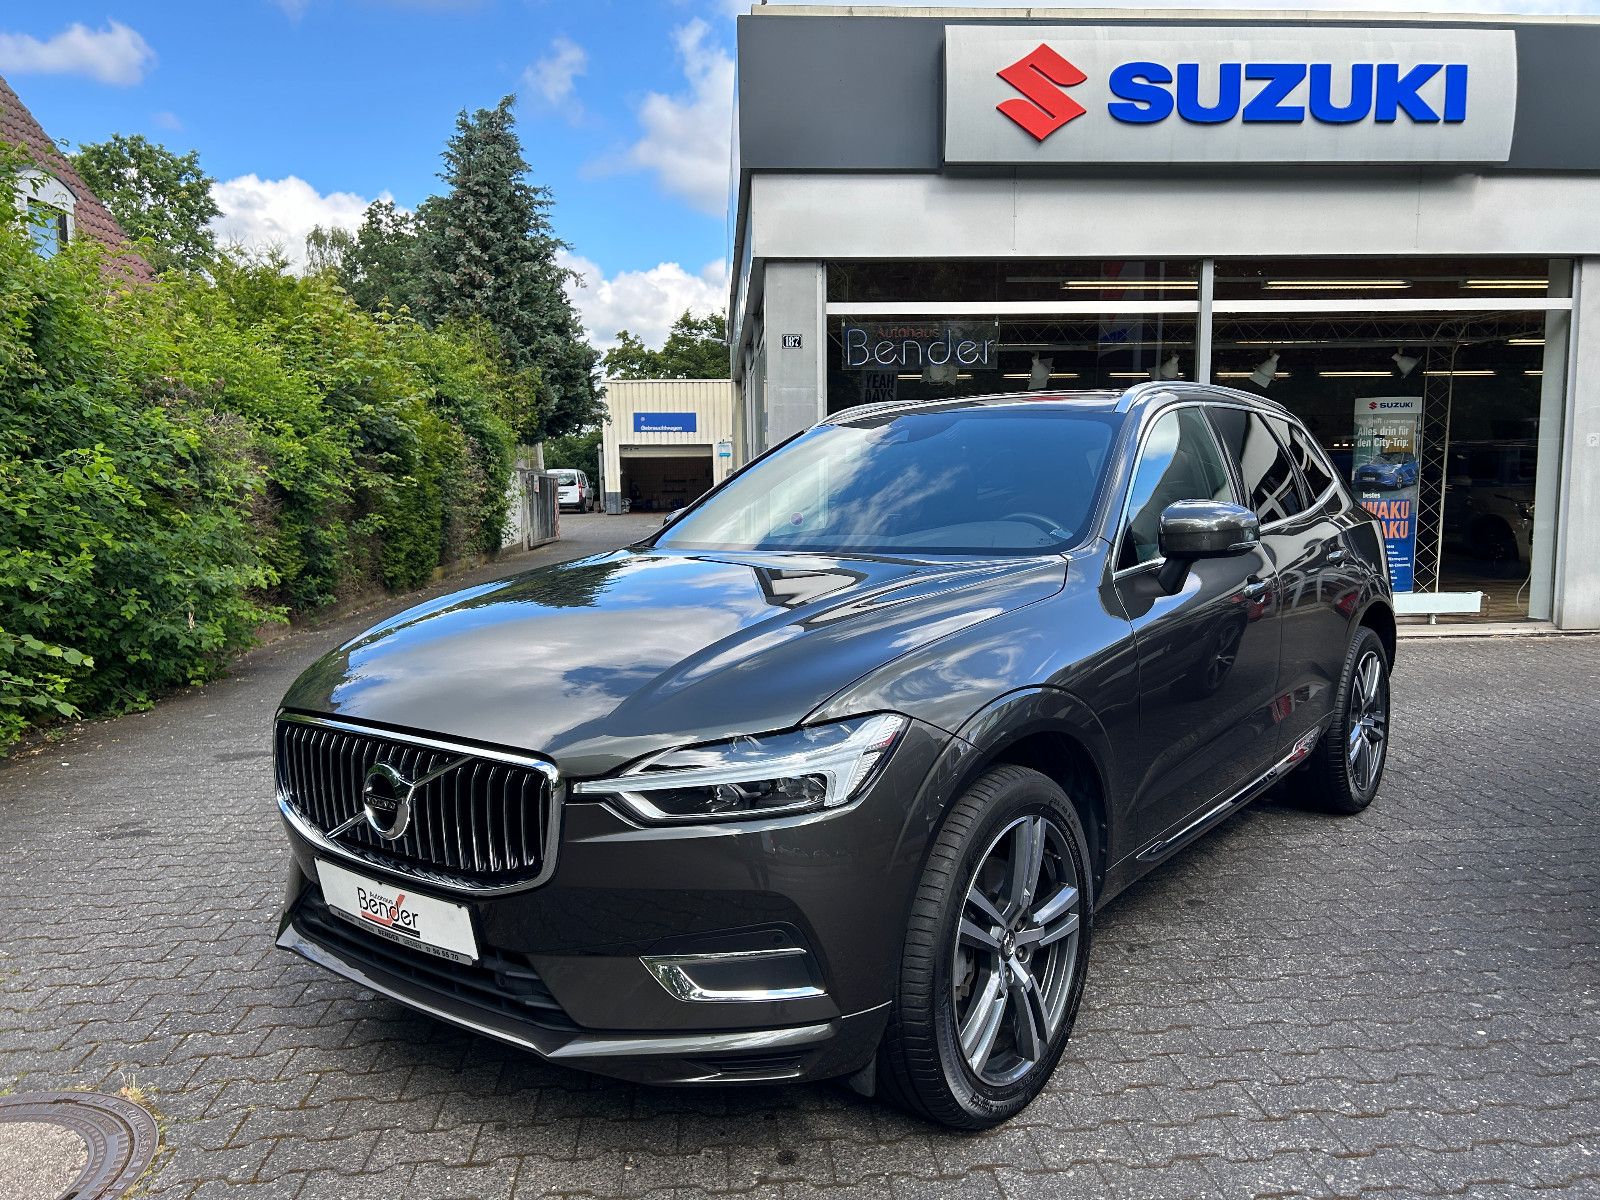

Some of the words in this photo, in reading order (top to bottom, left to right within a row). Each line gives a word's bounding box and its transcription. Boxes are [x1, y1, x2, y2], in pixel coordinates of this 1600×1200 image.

[1107, 61, 1469, 125] SUZUKI
[877, 326, 940, 339] Autohaus
[784, 336, 800, 347] 187
[847, 329, 996, 366] Bender
[866, 374, 895, 388] YEAH
[865, 389, 894, 402] DAYS
[1357, 427, 1378, 436] Alles
[1380, 426, 1396, 436] drin
[1398, 426, 1410, 436] für
[1357, 438, 1371, 447] den
[1374, 437, 1409, 449] City-Trip:
[357, 887, 419, 928] Bender
